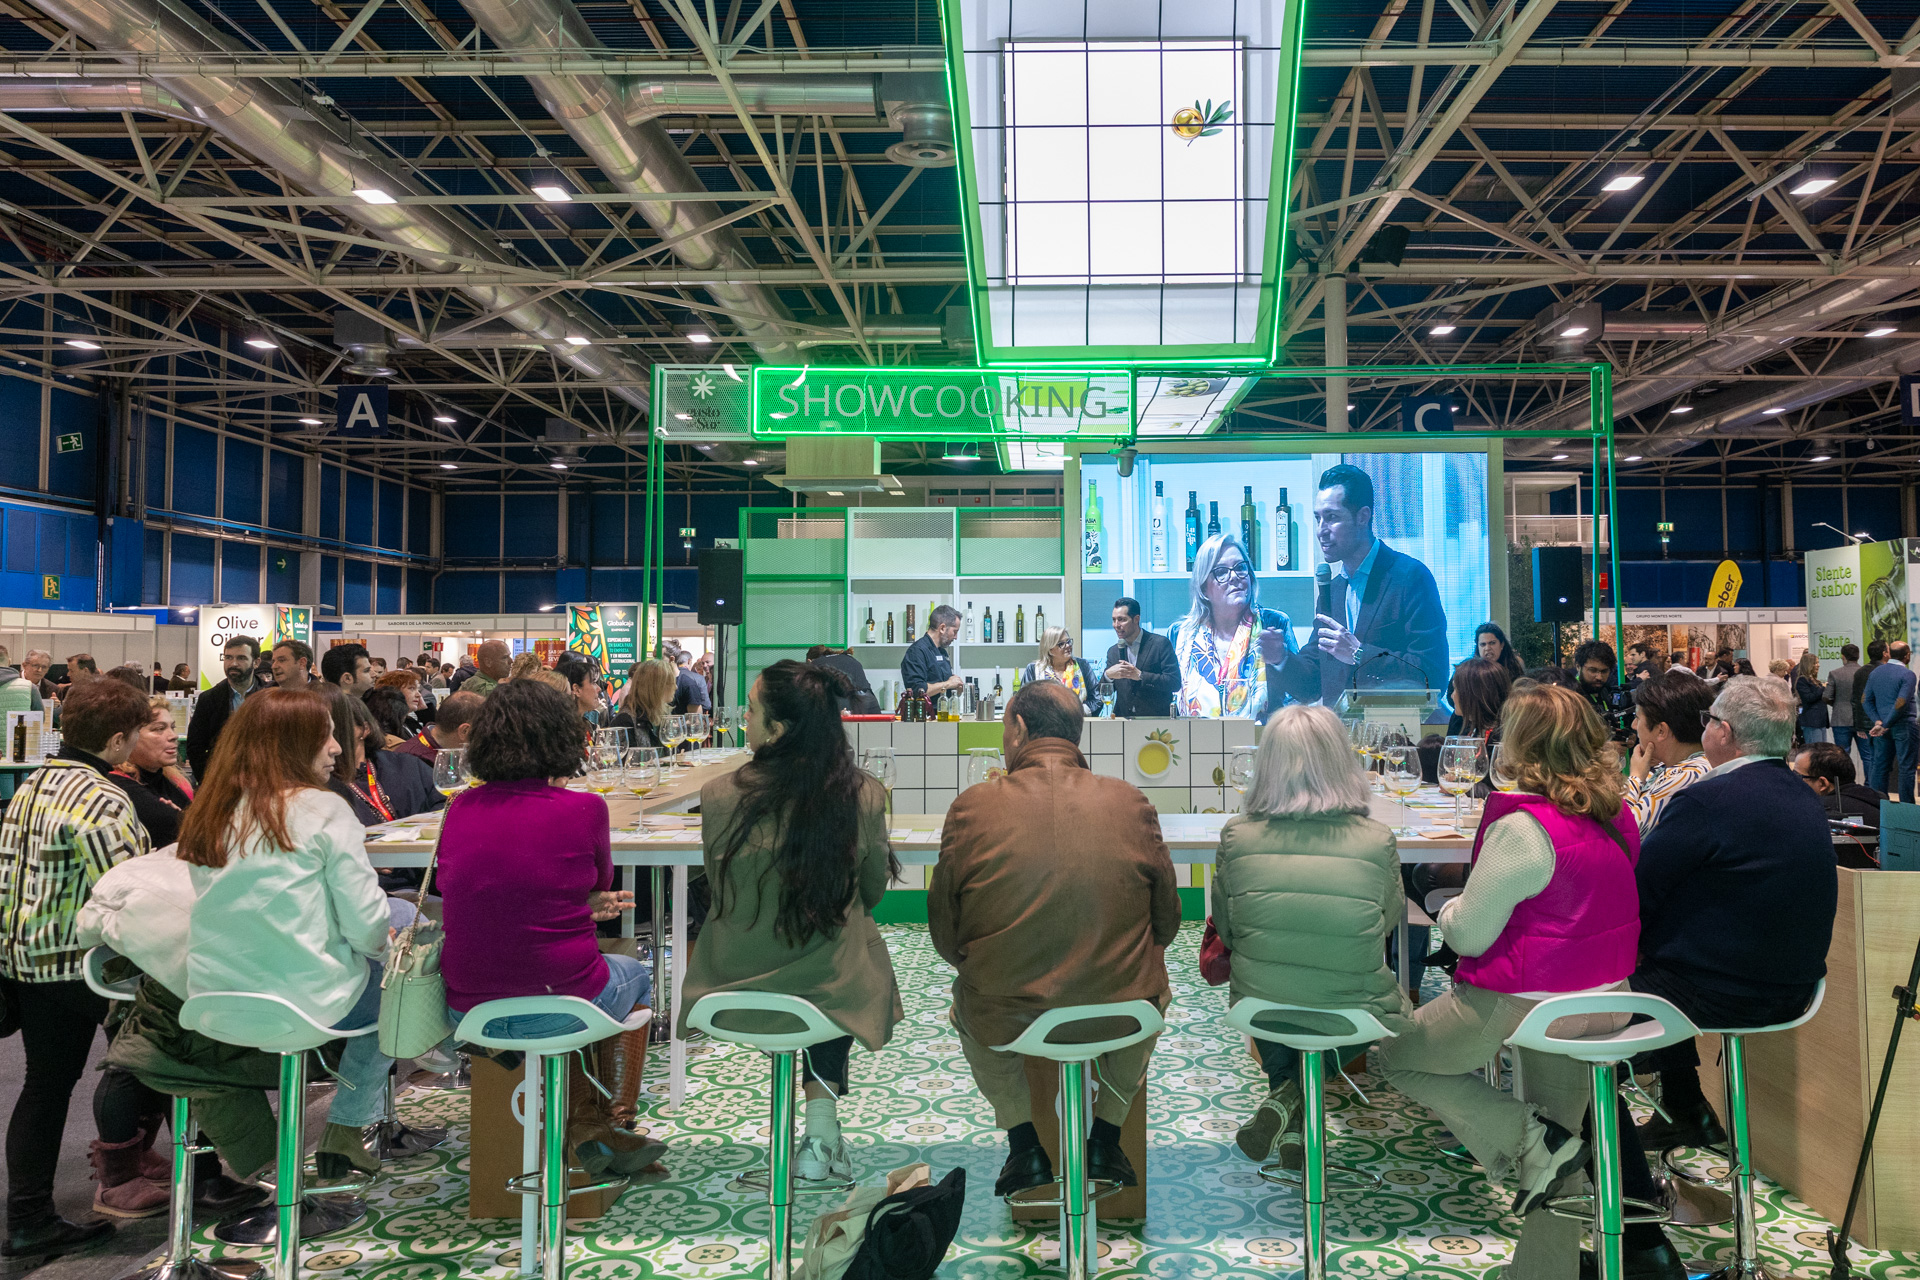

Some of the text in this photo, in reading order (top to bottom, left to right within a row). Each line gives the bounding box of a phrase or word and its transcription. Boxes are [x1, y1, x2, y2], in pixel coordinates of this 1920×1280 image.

[778, 384, 1108, 418] SHOWCOOKING
[345, 393, 379, 428] A
[1414, 403, 1441, 432] C
[1815, 566, 1852, 582] Siente
[1718, 573, 1735, 608] eber
[1811, 581, 1858, 599] el sabor
[217, 616, 259, 629] Olive
[1818, 634, 1851, 648] Siente
[1818, 648, 1842, 660] Albac
